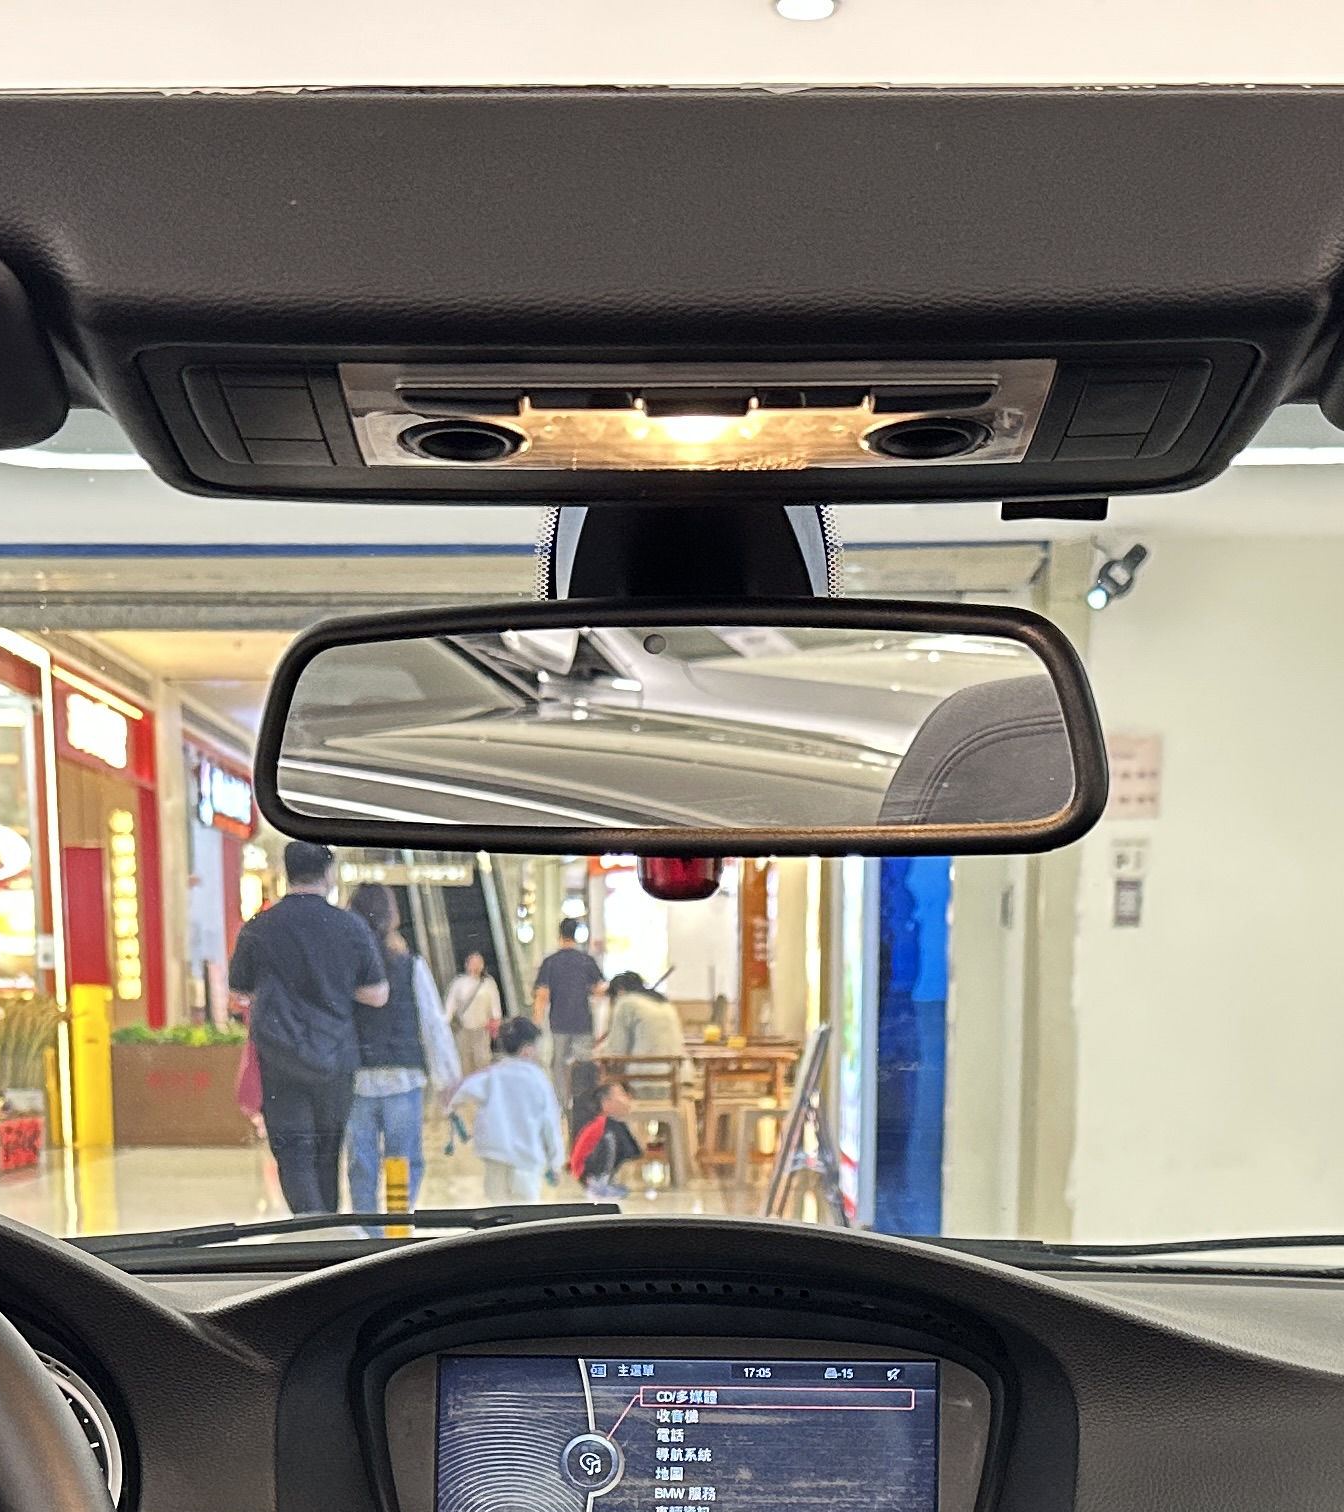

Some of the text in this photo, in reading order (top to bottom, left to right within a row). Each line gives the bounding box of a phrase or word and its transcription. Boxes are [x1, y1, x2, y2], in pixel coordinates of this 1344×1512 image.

[743, 1367, 772, 1378] 17:05
[656, 1409, 700, 1424] 收音機
[656, 1428, 685, 1443] 電話
[655, 1488, 685, 1499] BMW
